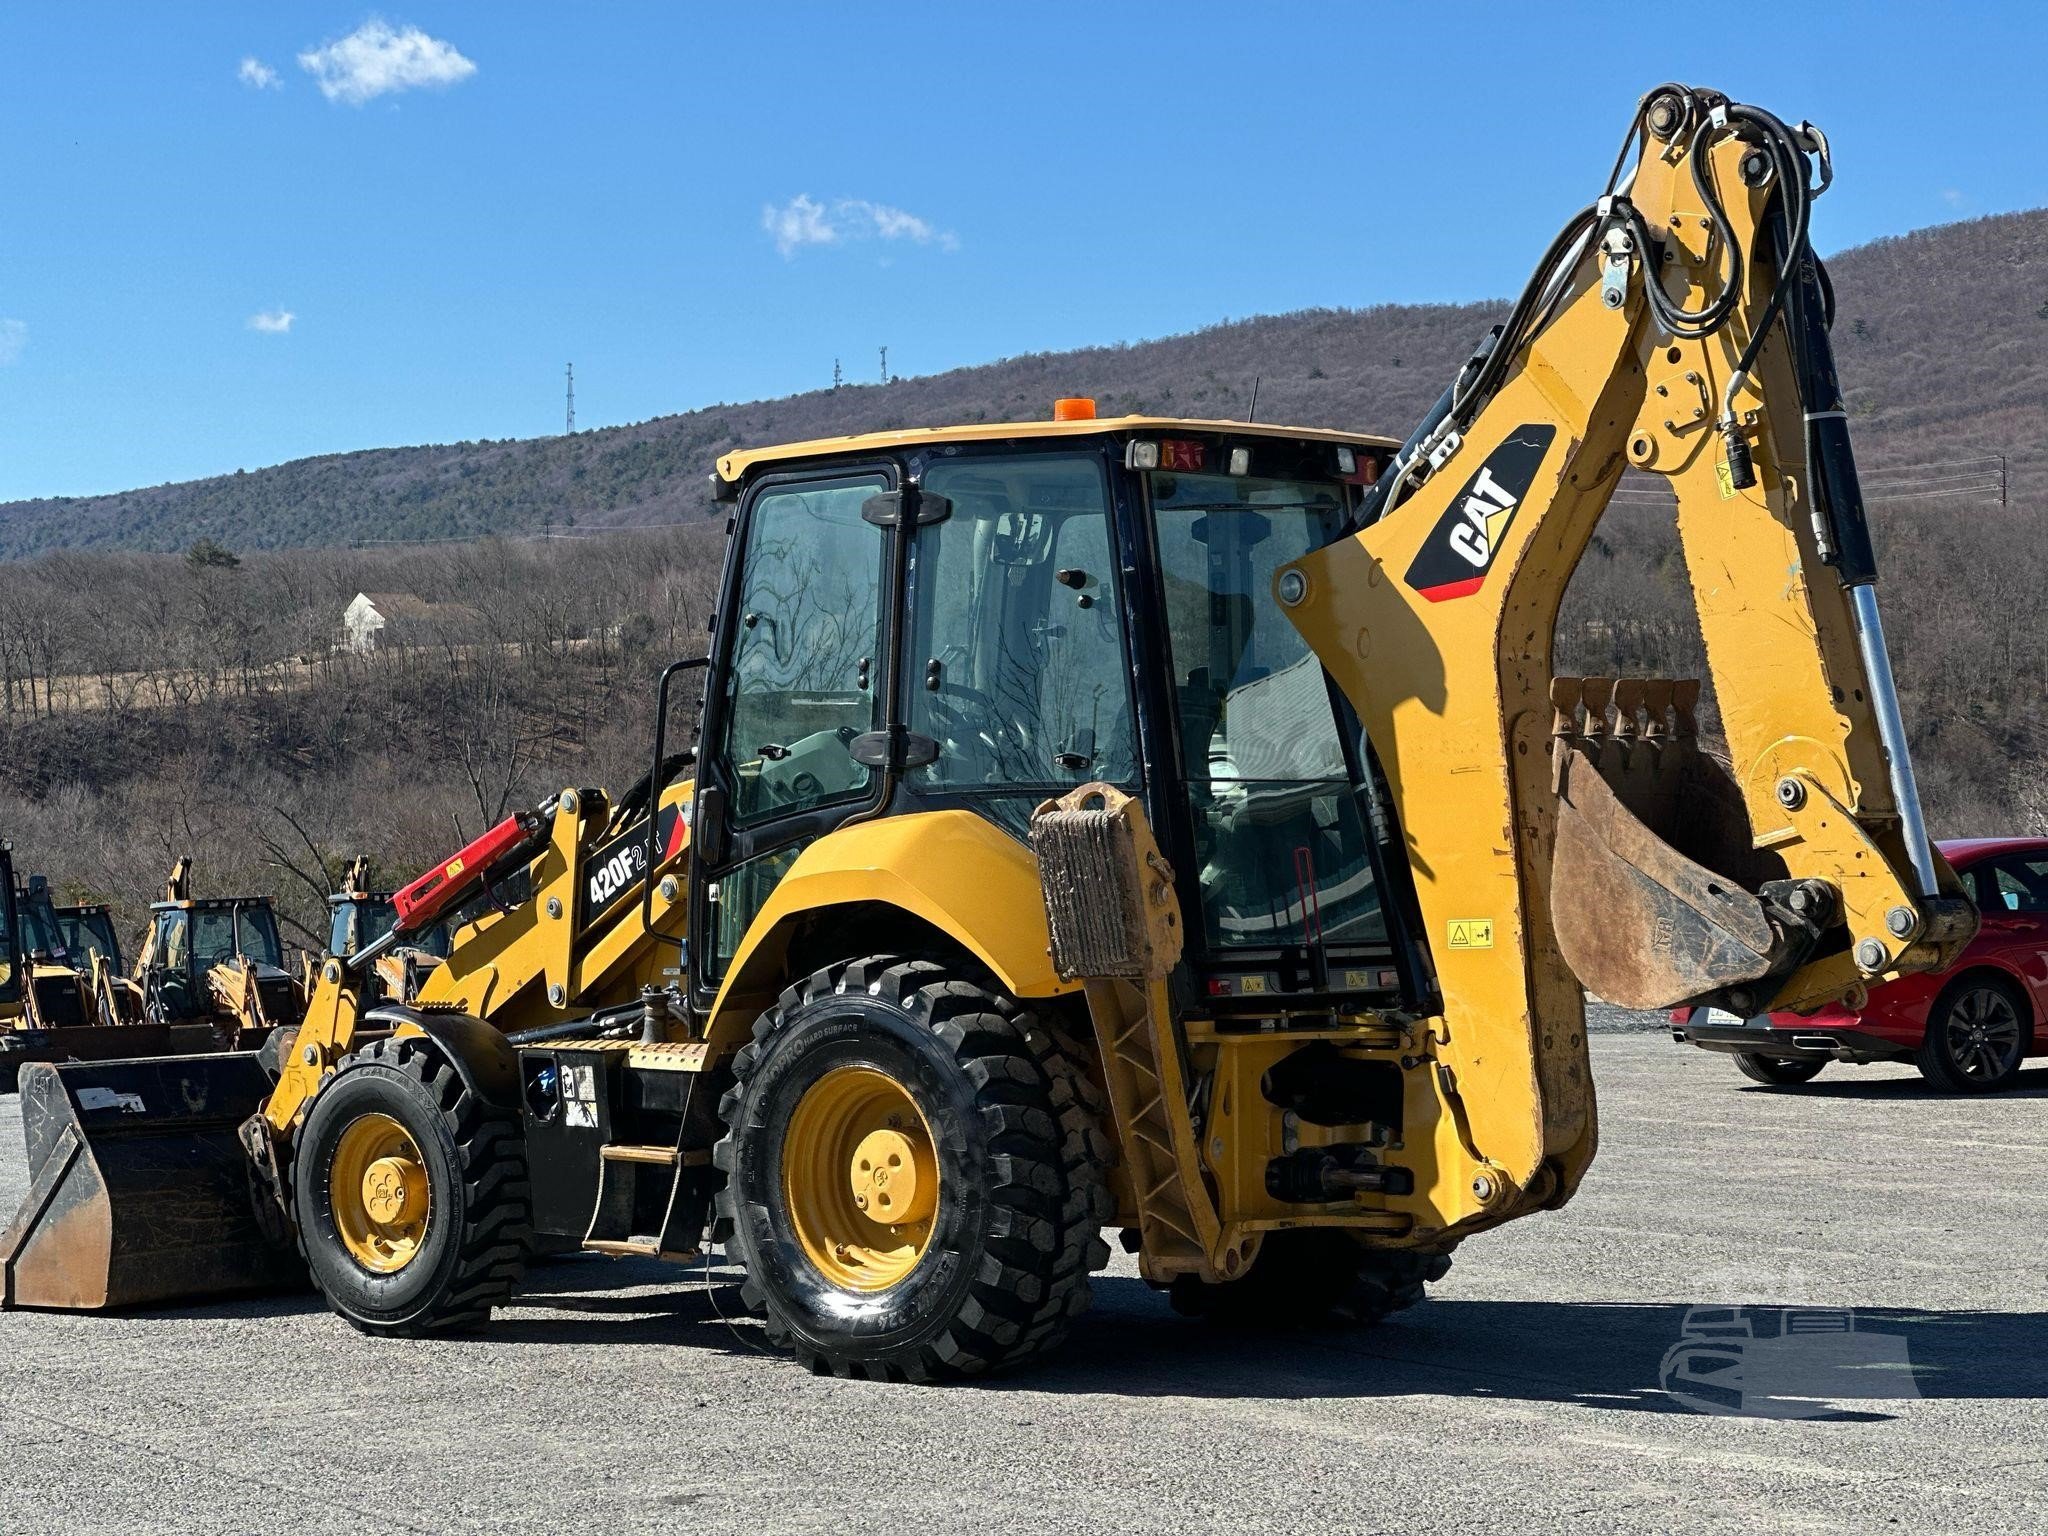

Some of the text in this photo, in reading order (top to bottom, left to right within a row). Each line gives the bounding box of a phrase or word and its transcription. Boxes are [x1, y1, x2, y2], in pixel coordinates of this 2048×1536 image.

[1449, 466, 1518, 568] CAT
[803, 1031, 824, 1046] HARD
[824, 1023, 858, 1037] SURFACE
